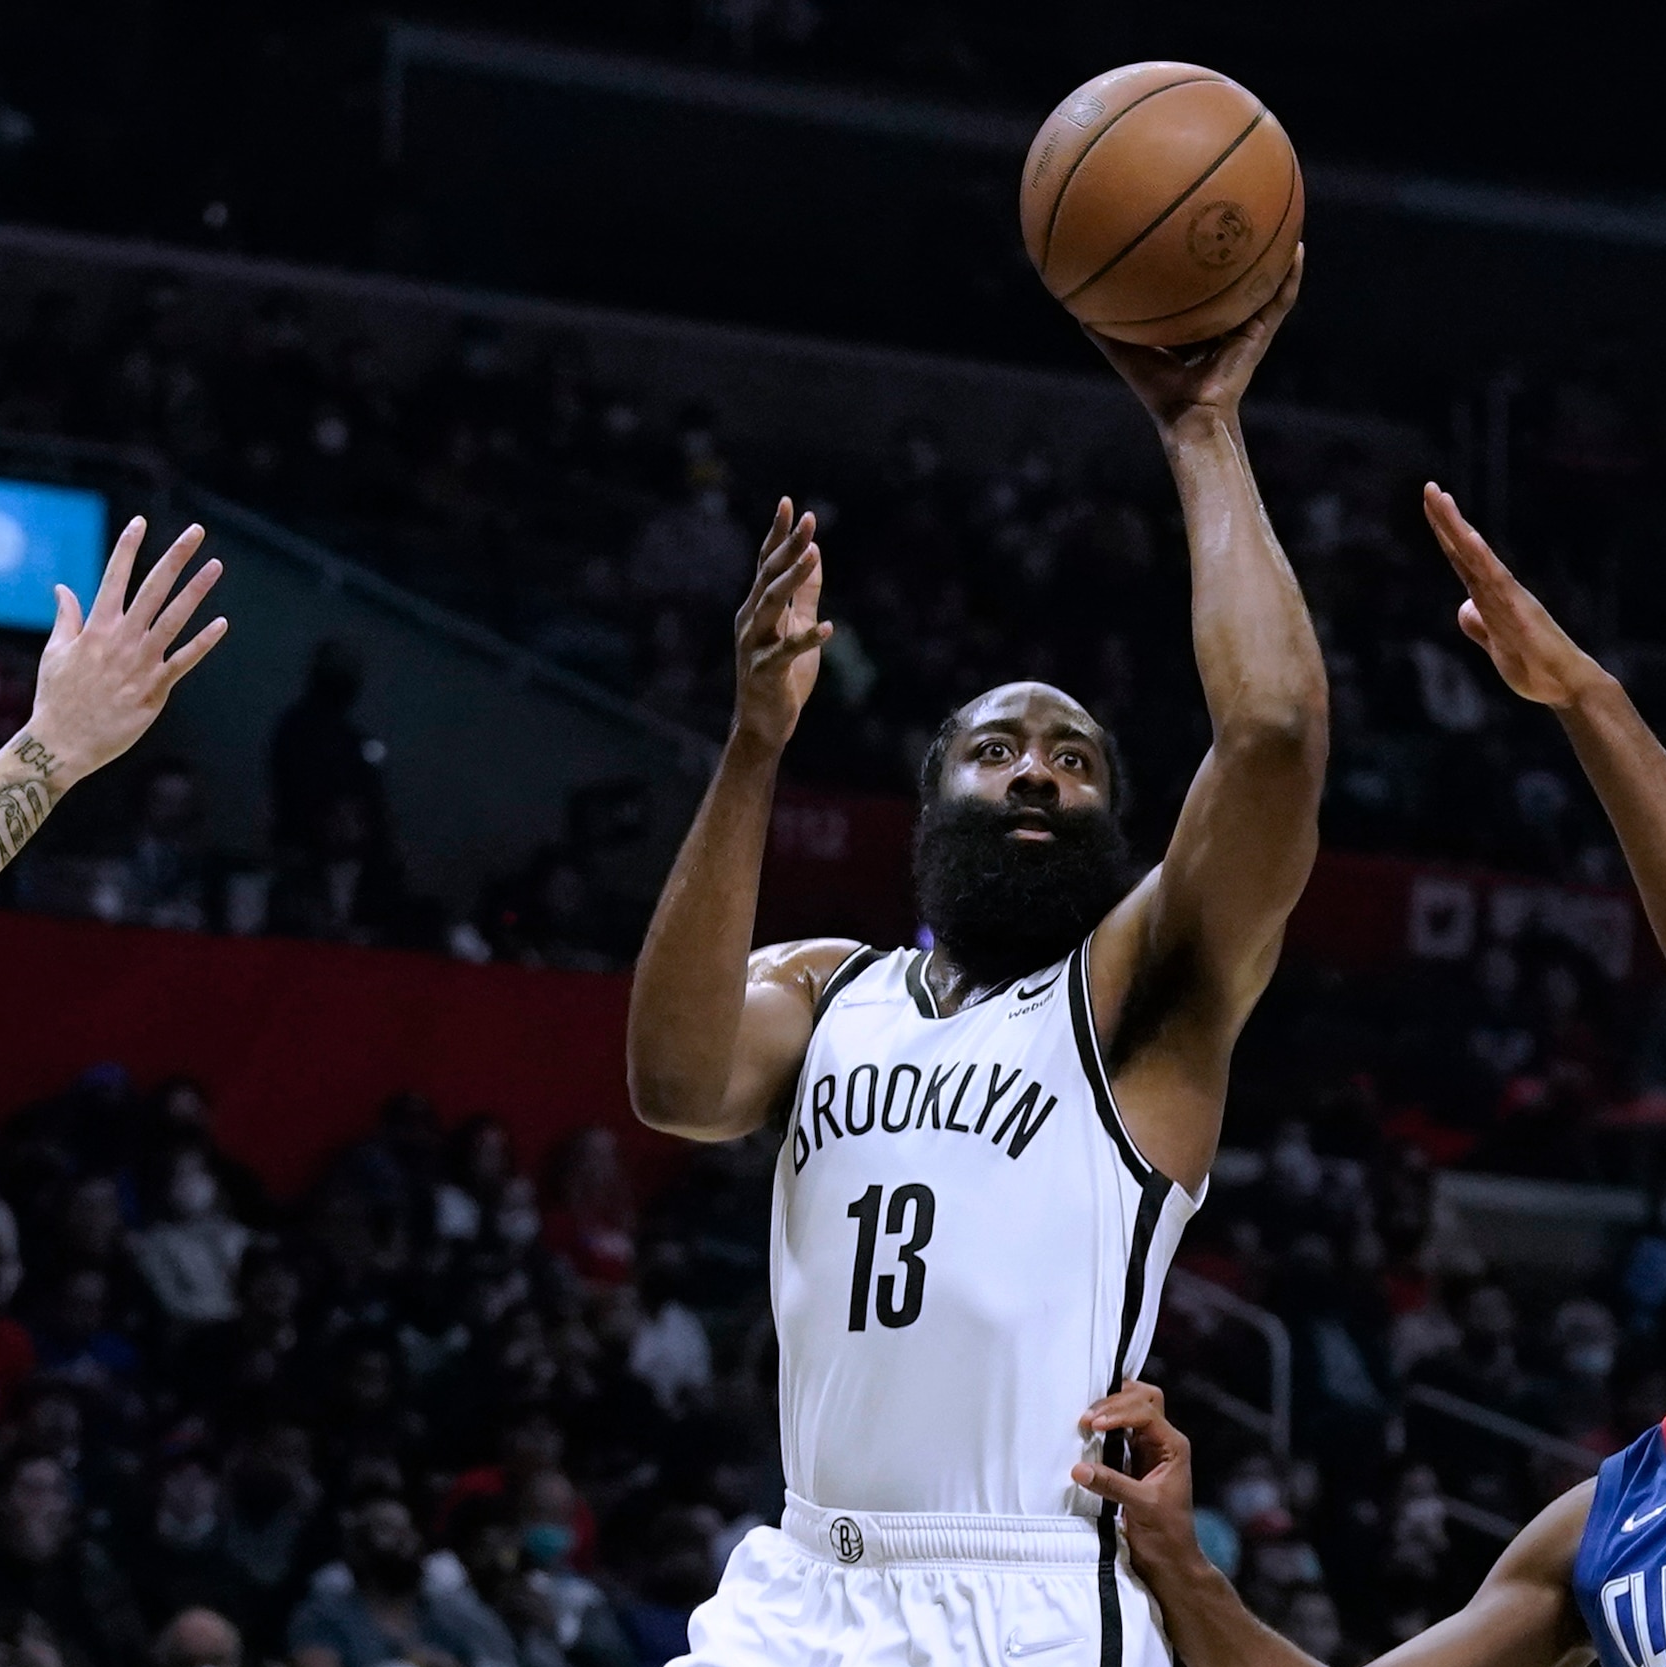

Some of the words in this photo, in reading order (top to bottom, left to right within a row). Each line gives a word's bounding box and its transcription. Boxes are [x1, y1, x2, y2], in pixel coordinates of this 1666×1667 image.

[1008, 988, 1055, 1020] Webull
[794, 1062, 1059, 1176] BROOKLYN
[847, 1183, 936, 1332] 13
